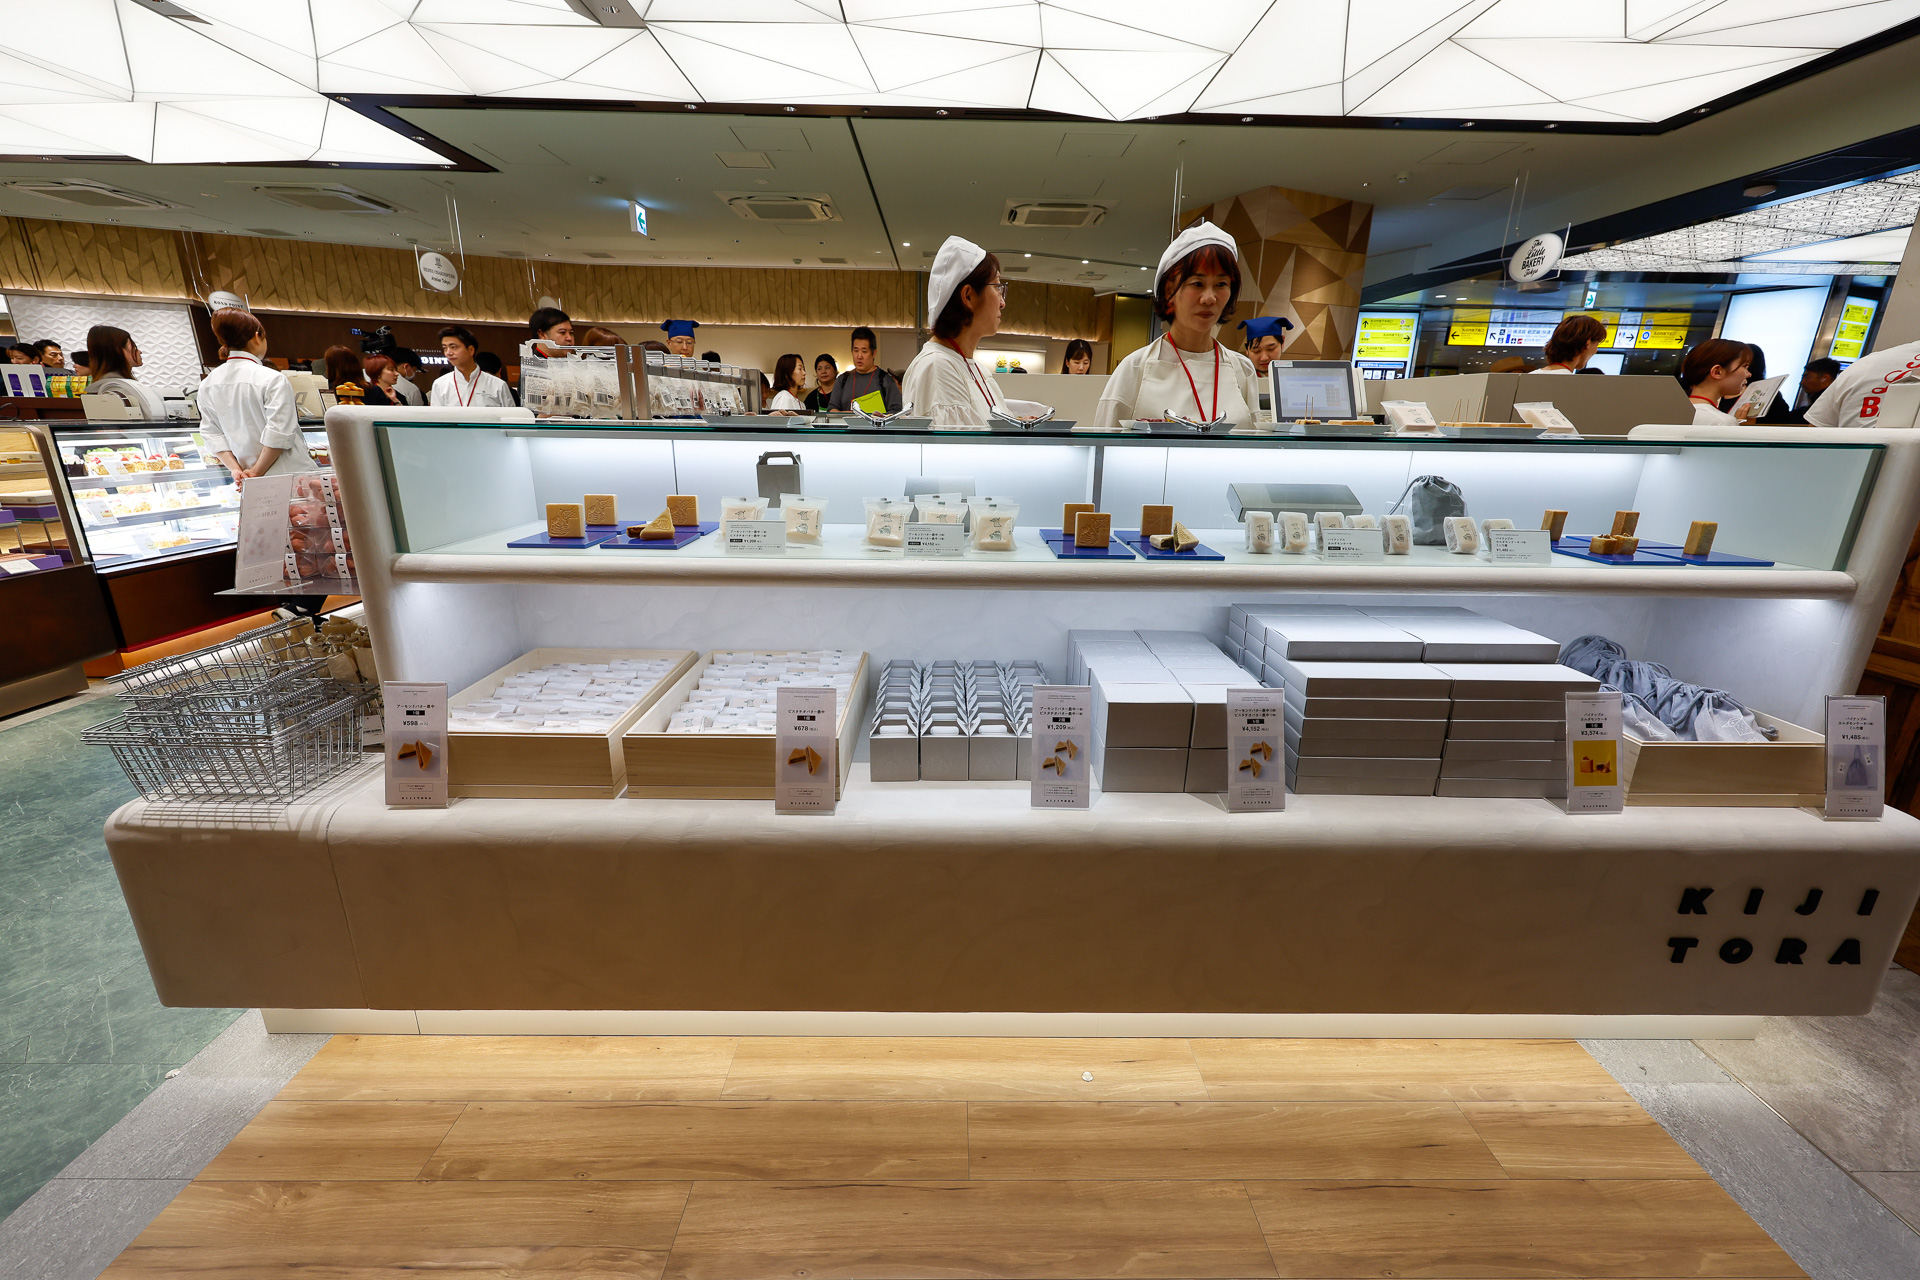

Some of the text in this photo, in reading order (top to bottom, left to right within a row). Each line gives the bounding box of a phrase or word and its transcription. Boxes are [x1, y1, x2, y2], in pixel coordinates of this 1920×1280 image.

[1525, 247, 1546, 260] Little
[1521, 255, 1546, 270] BAKERY
[420, 355, 449, 365] OINT
[1677, 888, 1880, 916] KIJI
[1667, 937, 1861, 965] TORA
